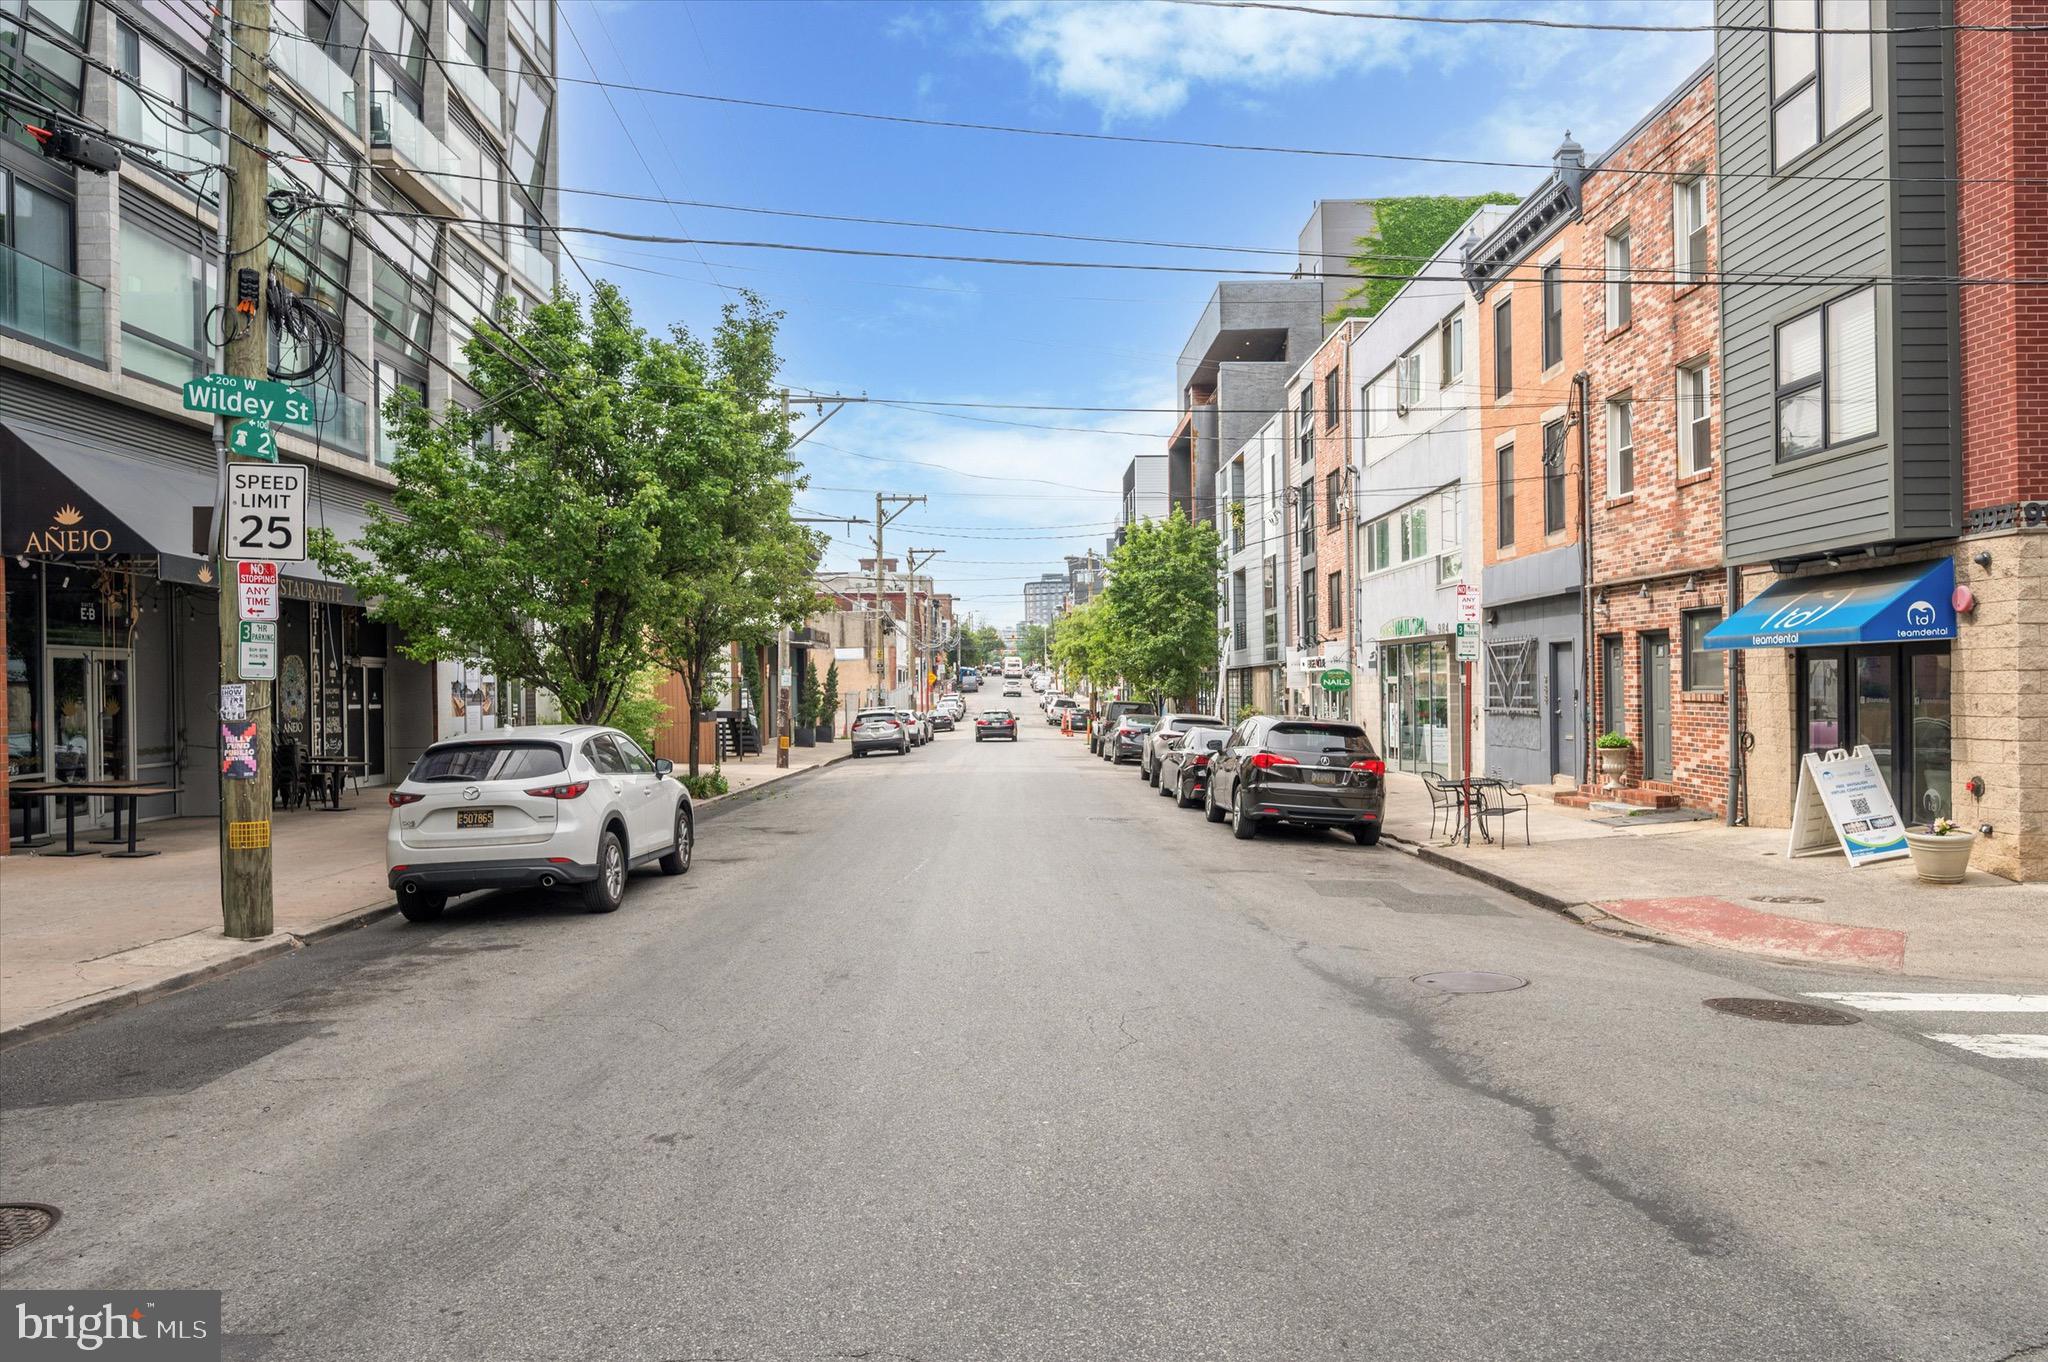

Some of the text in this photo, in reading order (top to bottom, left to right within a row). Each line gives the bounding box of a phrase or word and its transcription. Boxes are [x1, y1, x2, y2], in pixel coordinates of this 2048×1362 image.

[216, 376, 256, 391] 200 W
[188, 384, 309, 421] Wildey St
[235, 474, 298, 491] SPEED
[241, 493, 291, 509] LIMIT
[239, 514, 292, 549] 25
[24, 526, 112, 553] AÑEJO
[250, 563, 265, 575] NO
[240, 574, 276, 584] STOPPING
[246, 587, 270, 596] ANY
[246, 597, 271, 606] TIME
[1916, 614, 1929, 625] td
[242, 624, 250, 640] 3
[1752, 632, 1799, 645] teamdental
[1897, 627, 1948, 637] teamdental
[224, 749, 255, 757] PUBLIC
